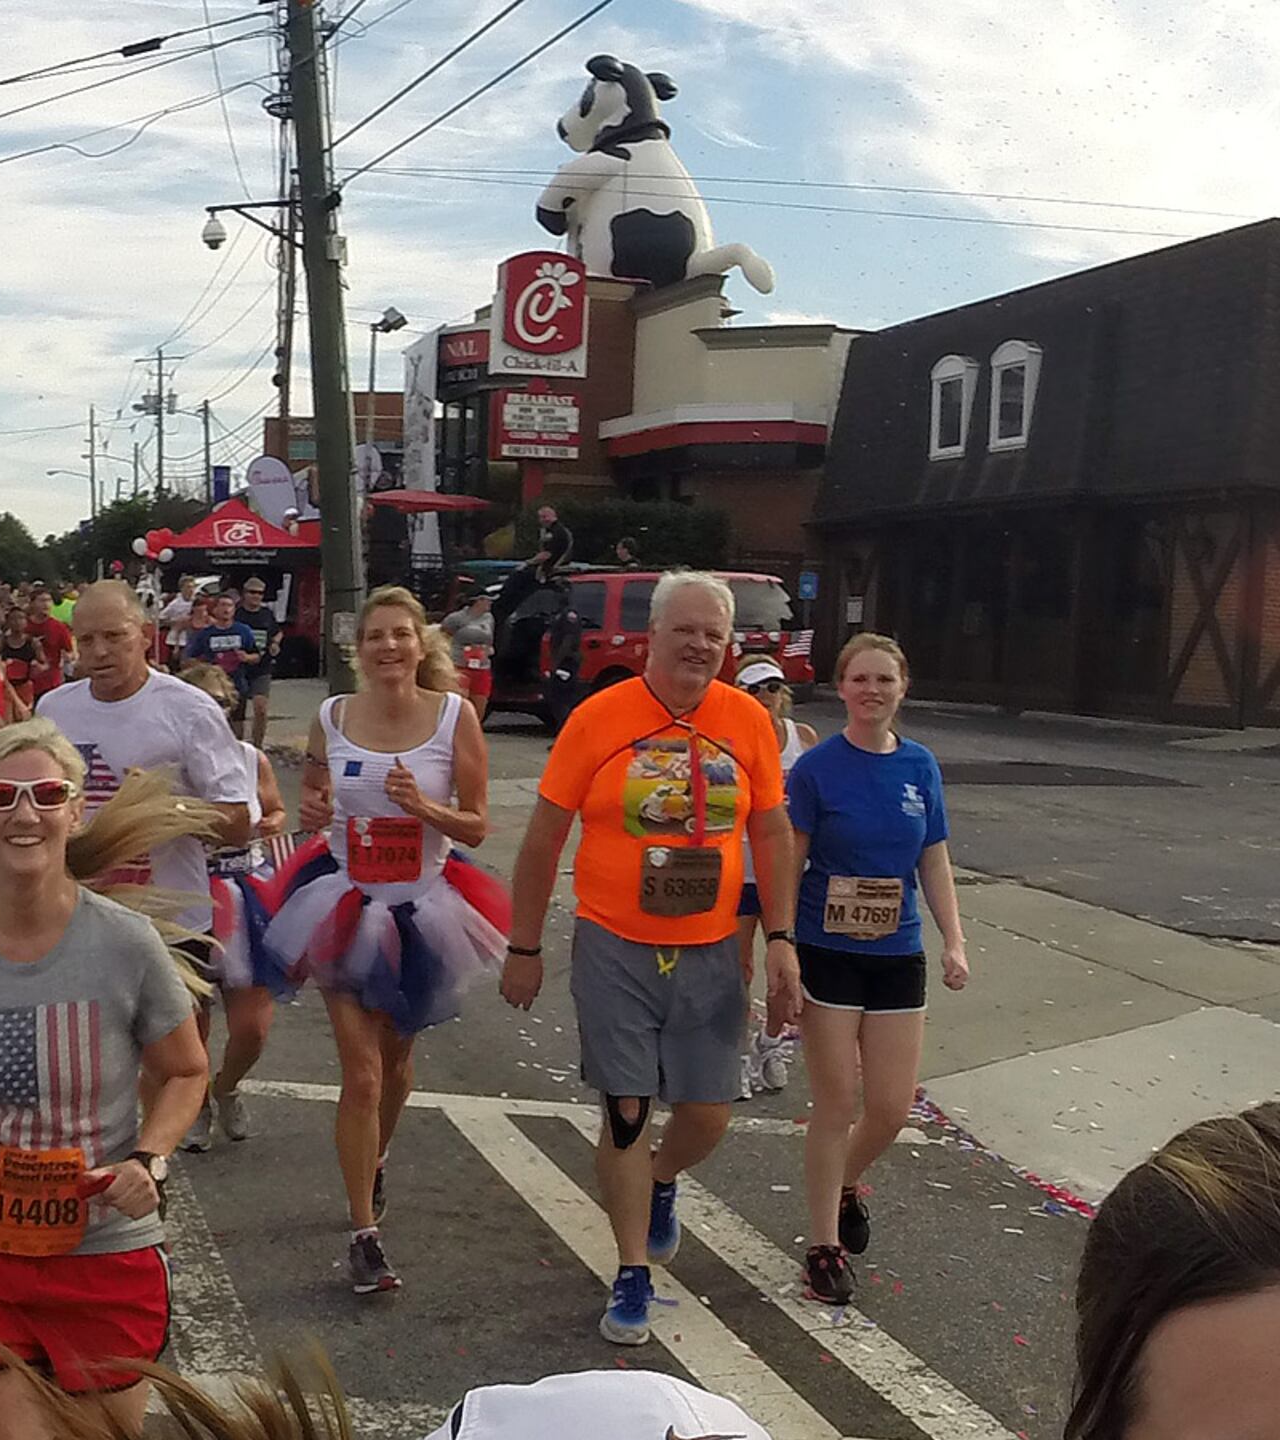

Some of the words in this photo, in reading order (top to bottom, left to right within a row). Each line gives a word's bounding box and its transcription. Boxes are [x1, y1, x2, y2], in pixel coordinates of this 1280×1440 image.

[503, 355, 578, 373] Chick-fil-A
[827, 903, 846, 922] M
[851, 906, 898, 924] 47691
